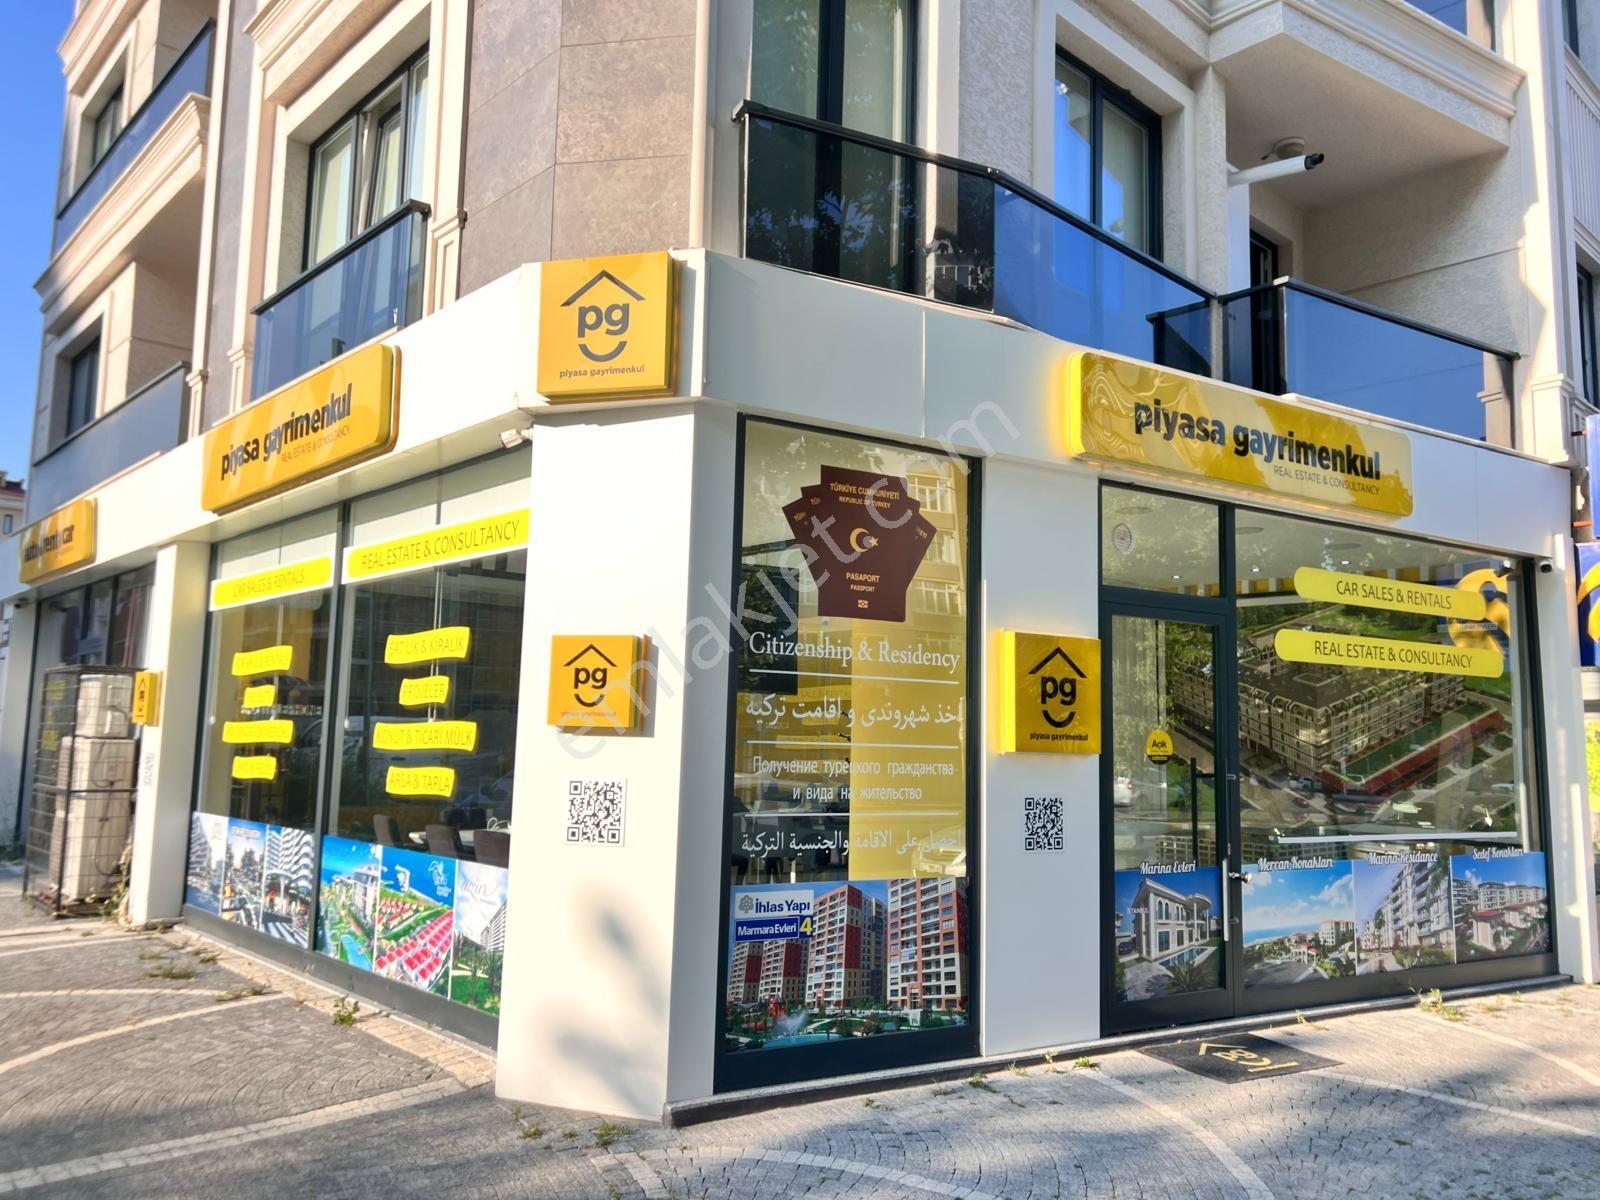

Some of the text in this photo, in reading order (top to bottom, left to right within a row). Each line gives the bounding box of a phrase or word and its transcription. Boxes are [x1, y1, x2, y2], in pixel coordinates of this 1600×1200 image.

[578, 303, 630, 338] pg
[560, 364, 645, 379] piyasa gayrimenkul
[221, 383, 352, 481] piyasa gayrimenkul
[1135, 399, 1381, 480] piyasa gayrimenkul
[1274, 464, 1380, 496] REAL ESTATE & CONSULTANCY
[361, 520, 520, 570] REAL ESTATE & CONSULTANCY
[846, 572, 880, 583] PASAPORT
[1336, 579, 1452, 610] CAR SALES & RENTALS
[749, 631, 960, 675] Citizenship & Residency
[1315, 641, 1473, 669] REAL ESTATE & CONSULTANCY
[574, 667, 608, 690] pg
[1041, 676, 1077, 706] pg
[792, 696, 842, 719] اقامت
[846, 707, 856, 728] و
[1030, 731, 1089, 741] piyasa gayrimenkul
[753, 756, 818, 777] Получение
[887, 760, 954, 778] гражданства
[793, 786, 923, 803] и вида на жительство
[742, 831, 784, 859] التركية
[789, 829, 850, 856] والجنسية
[1140, 859, 1196, 875] Marina Evleri
[1257, 856, 1290, 872] Mercan
[755, 897, 811, 915] İhlas Yapı
[737, 922, 797, 937] Marmara Evleri
[799, 917, 813, 935] 4
